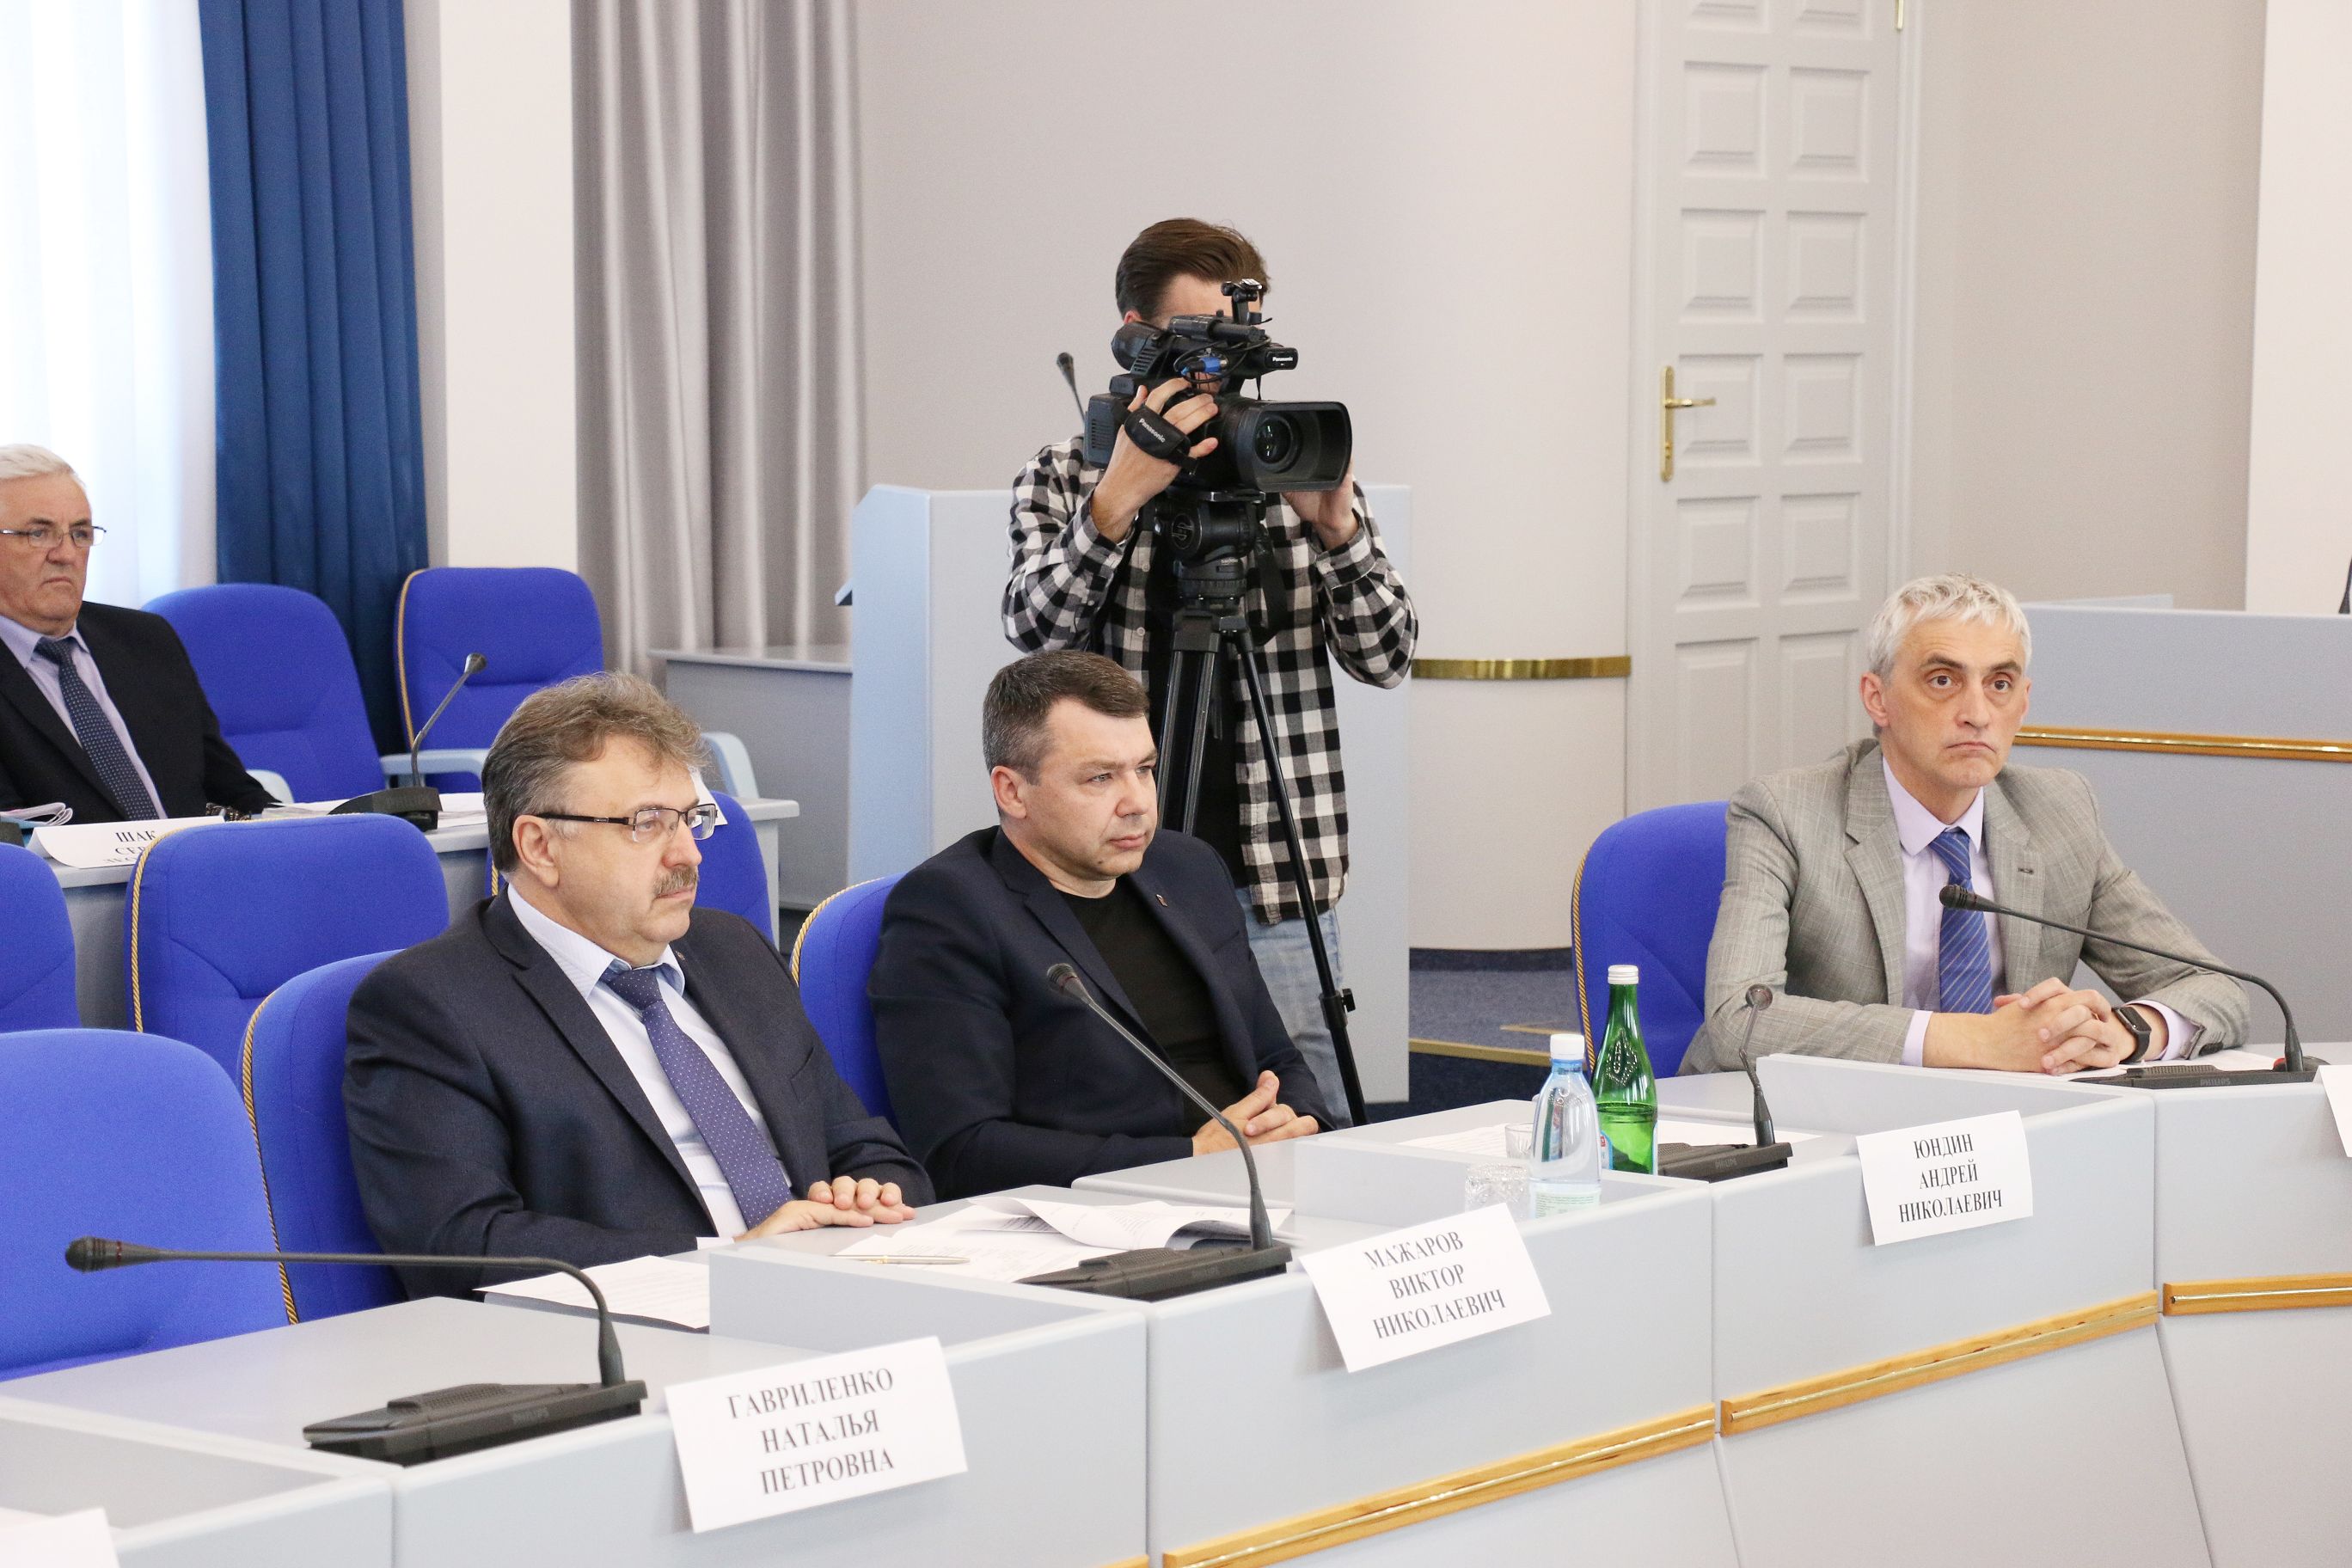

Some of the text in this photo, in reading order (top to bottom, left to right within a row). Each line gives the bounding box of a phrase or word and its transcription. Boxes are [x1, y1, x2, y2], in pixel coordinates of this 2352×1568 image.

[1138, 418, 1166, 443] Panasonic
[1914, 1134, 1974, 1159] ЮНДИН
[1919, 1159, 1978, 1190] АНДРЕЙ
[1898, 1189, 2003, 1223] НИКОЛАЕВИЧ
[1363, 1231, 1463, 1270] МАЖАРОВ
[1388, 1264, 1464, 1299] ВИКТОР
[1372, 1289, 1506, 1338] НИКОЛАЕВИЧ
[726, 1368, 894, 1418] ГАВРИЛЕНКО
[761, 1409, 880, 1454] НАТАЛЬЯ
[759, 1448, 895, 1495] ПЕТРОВНА
